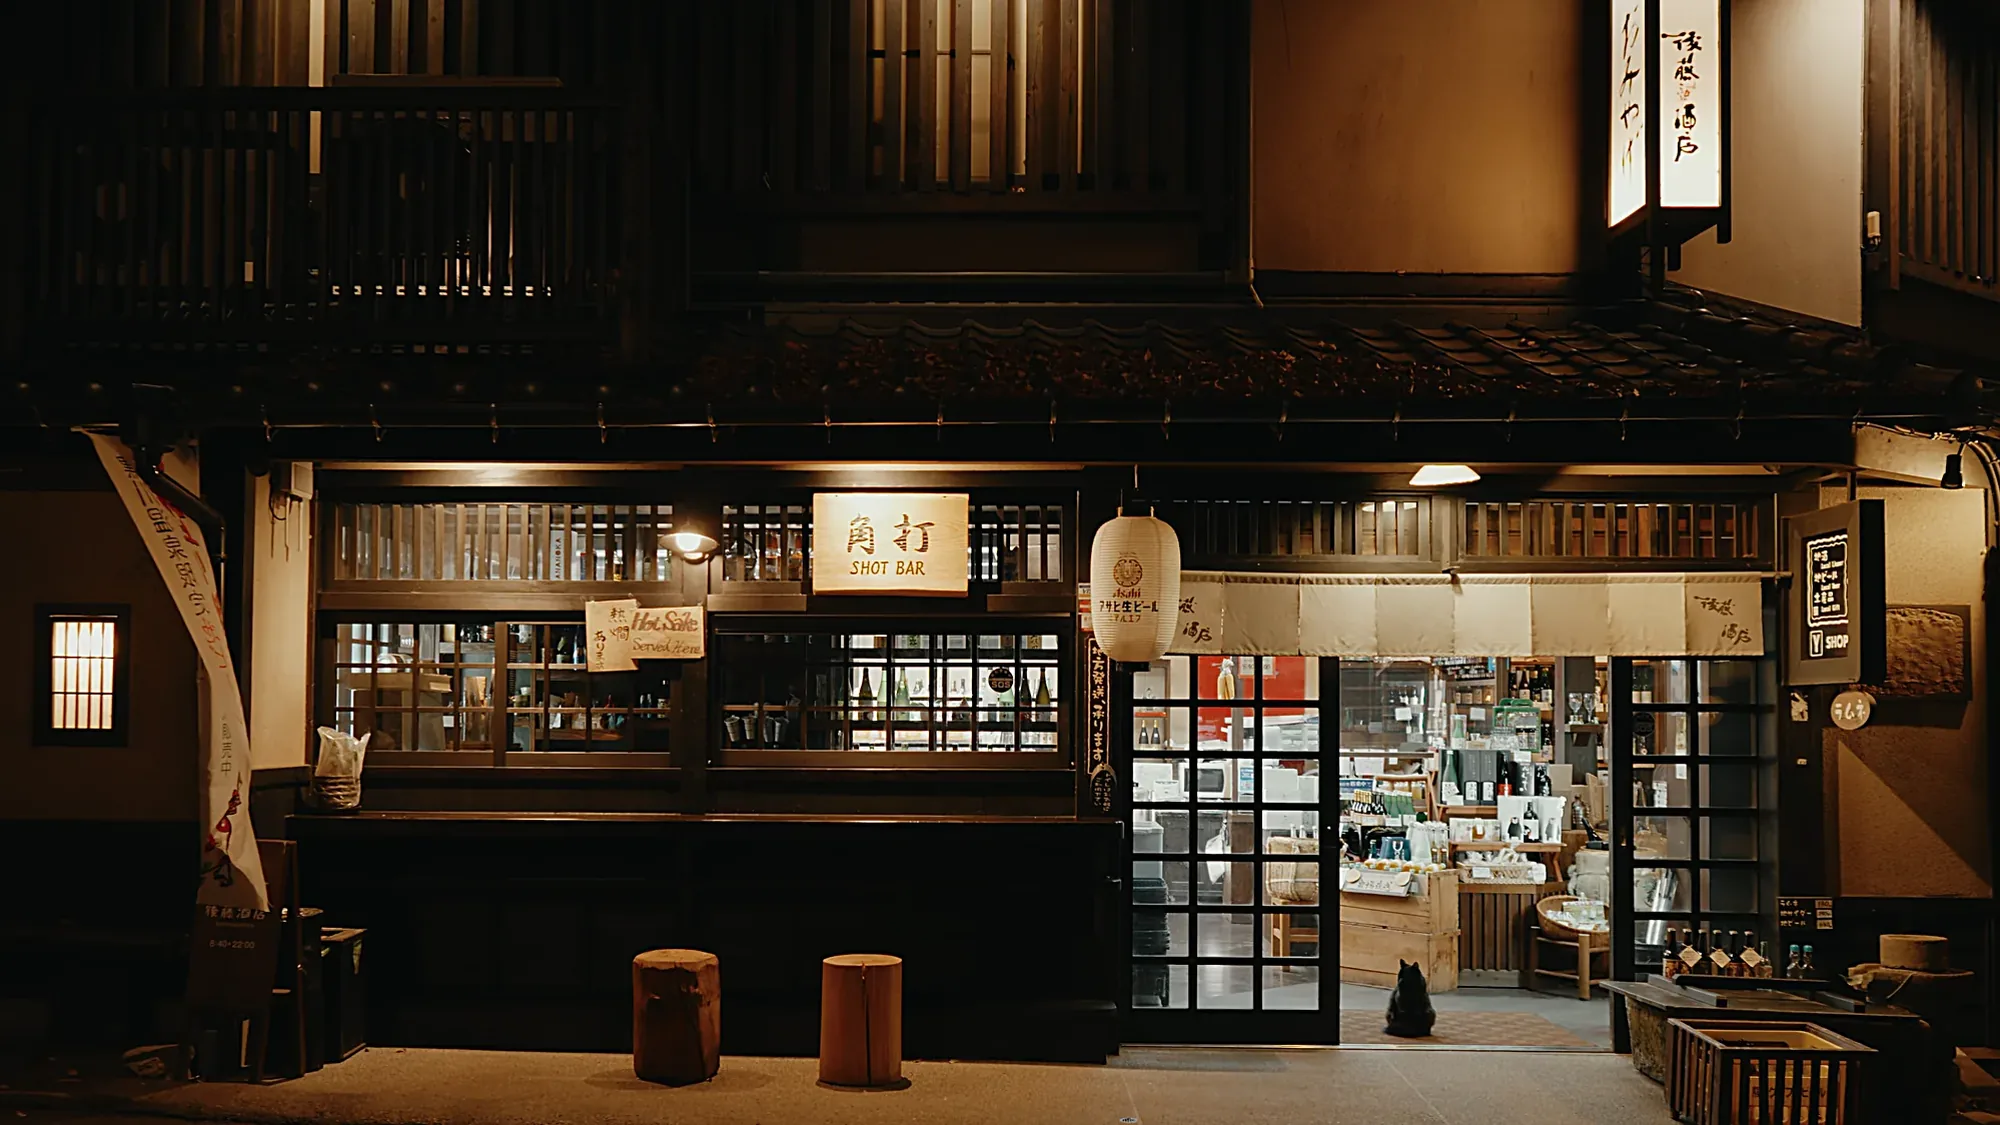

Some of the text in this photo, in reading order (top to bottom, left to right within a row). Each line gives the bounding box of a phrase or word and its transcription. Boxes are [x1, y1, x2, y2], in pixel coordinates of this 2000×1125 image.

[1619, 4, 1644, 182] おみやげ
[847, 513, 935, 555] 角打
[850, 560, 925, 575] SHOT BAR
[1113, 587, 1141, 599] Asahi
[1099, 600, 1159, 613] アサヒ生ビール
[608, 607, 630, 641] 熱燗
[631, 610, 698, 632] Hot Sake
[632, 637, 701, 655] Served Here
[1825, 634, 1849, 649] SHOP
[991, 680, 1011, 689] SOS
